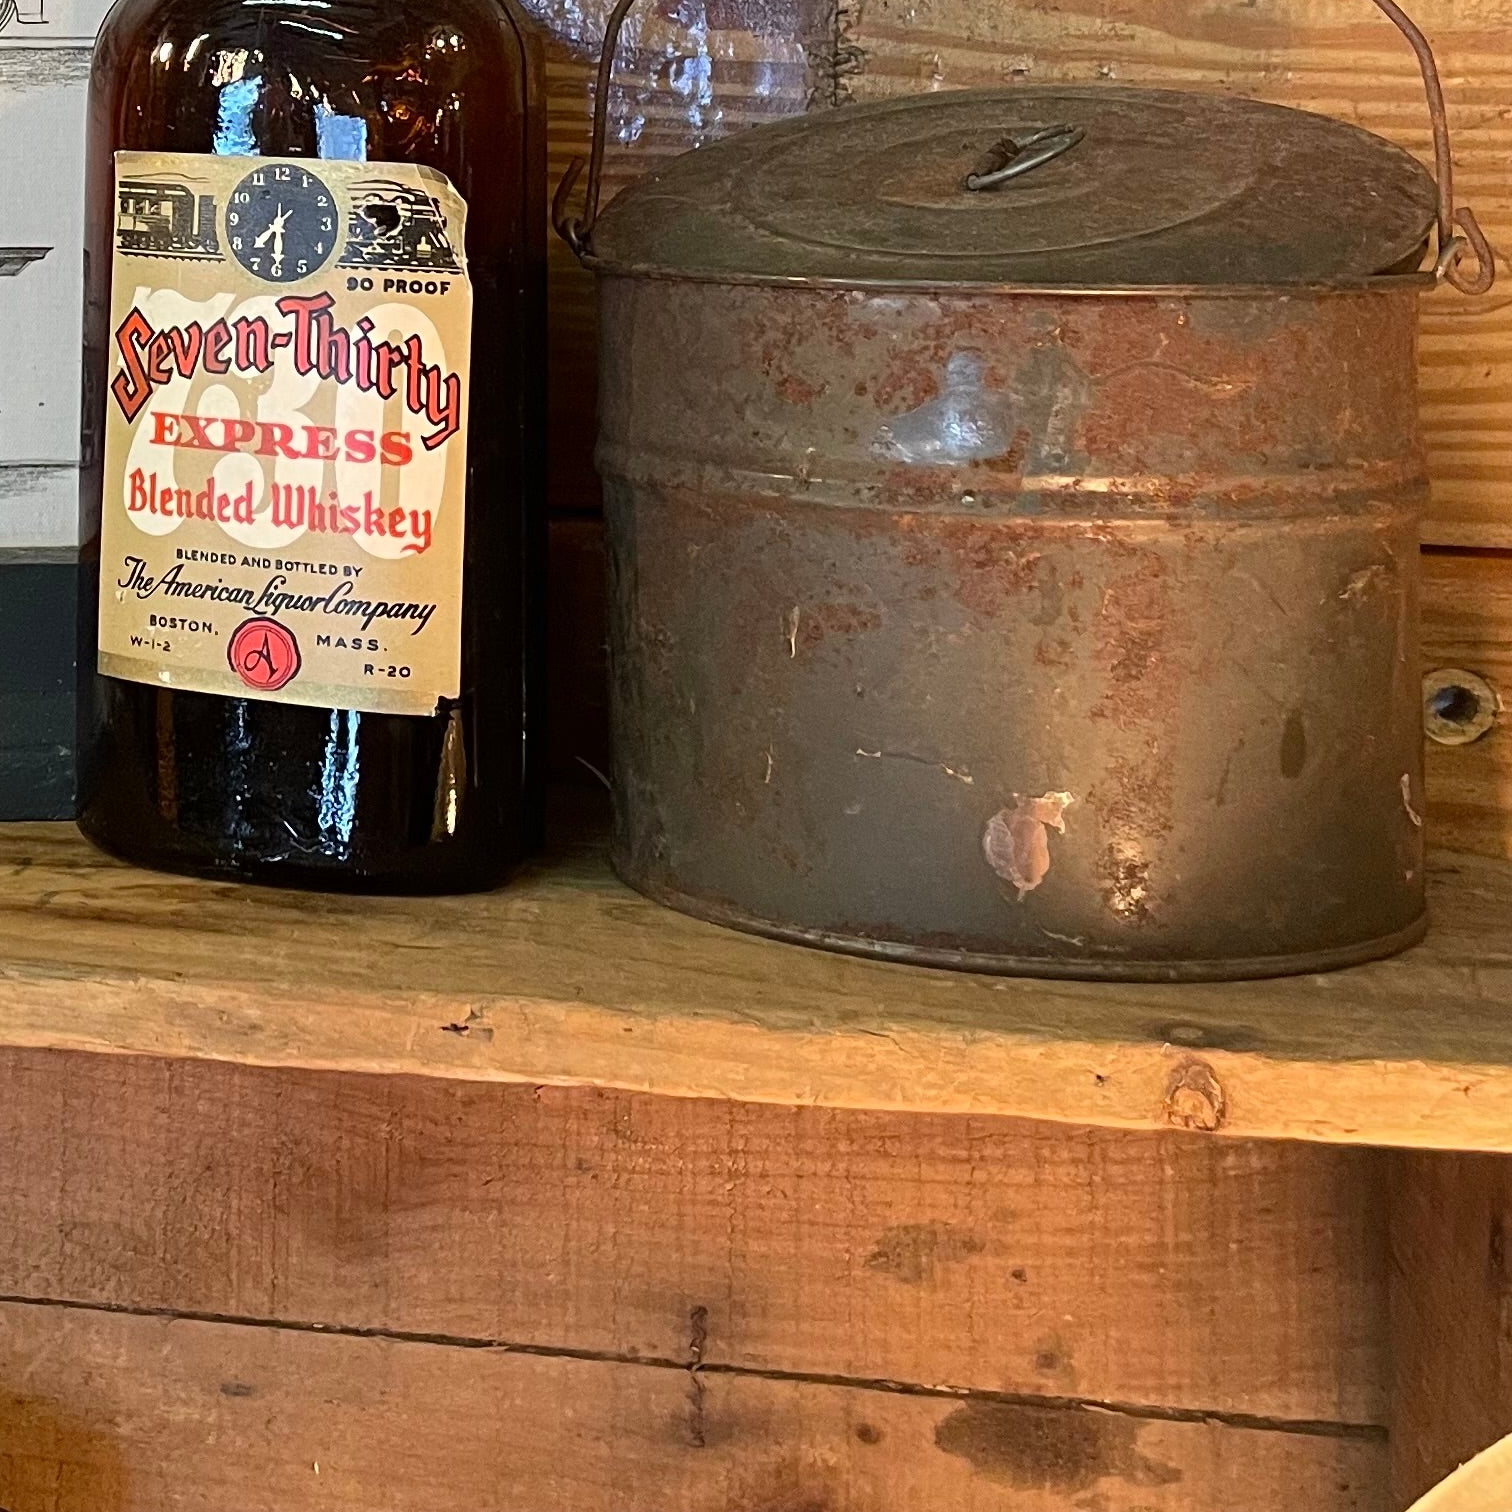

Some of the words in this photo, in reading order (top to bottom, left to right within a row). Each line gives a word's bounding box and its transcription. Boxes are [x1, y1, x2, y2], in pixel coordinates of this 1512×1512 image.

[252, 173, 265, 186] 11
[275, 167, 291, 181] 12
[234, 192, 250, 204] 10
[317, 195, 328, 207] 2
[229, 212, 239, 226] 9
[320, 216, 332, 231] 3
[232, 236, 243, 250] 8
[250, 257, 261, 271] 7
[271, 263, 282, 277] 6
[296, 259, 307, 273] 5
[346, 276, 374, 292] 90
[383, 278, 451, 296] PROOF
[111, 291, 461, 451] Seven-Thirty
[149, 410, 414, 467] EXPRESS
[127, 467, 257, 526] Blended
[271, 482, 433, 554] Whiskey
[175, 548, 238, 566] BLENDED
[240, 552, 272, 570] AND
[274, 556, 338, 577] BOTTLED
[344, 564, 364, 578] BY
[118, 556, 153, 590] The
[138, 563, 254, 608] American
[244, 575, 326, 616] Liquor
[322, 581, 437, 636] Company
[364, 663, 412, 679] R-20
